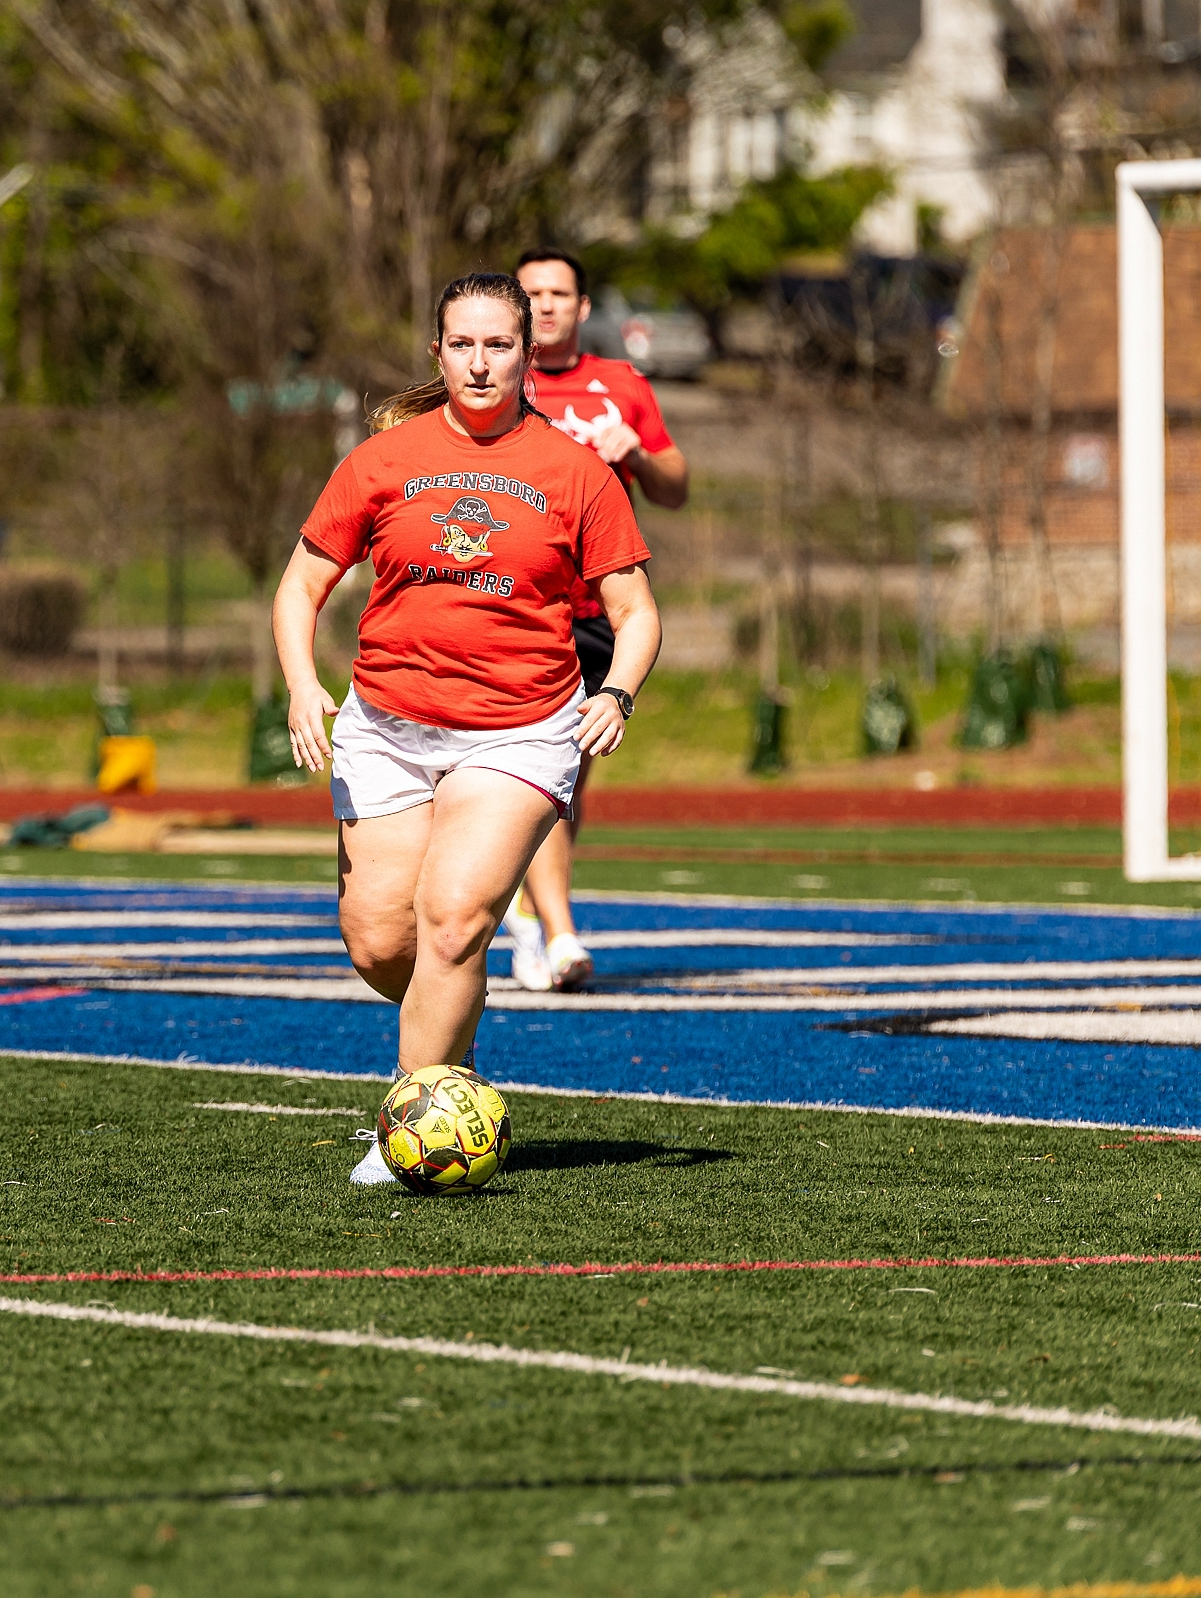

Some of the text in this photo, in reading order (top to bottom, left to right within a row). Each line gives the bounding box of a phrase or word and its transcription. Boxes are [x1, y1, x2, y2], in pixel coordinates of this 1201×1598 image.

[404, 472, 547, 514] GREENSBORO
[408, 564, 515, 597] RAIDERS
[438, 1115, 452, 1134] SELECT
[442, 1083, 490, 1148] SELECT
